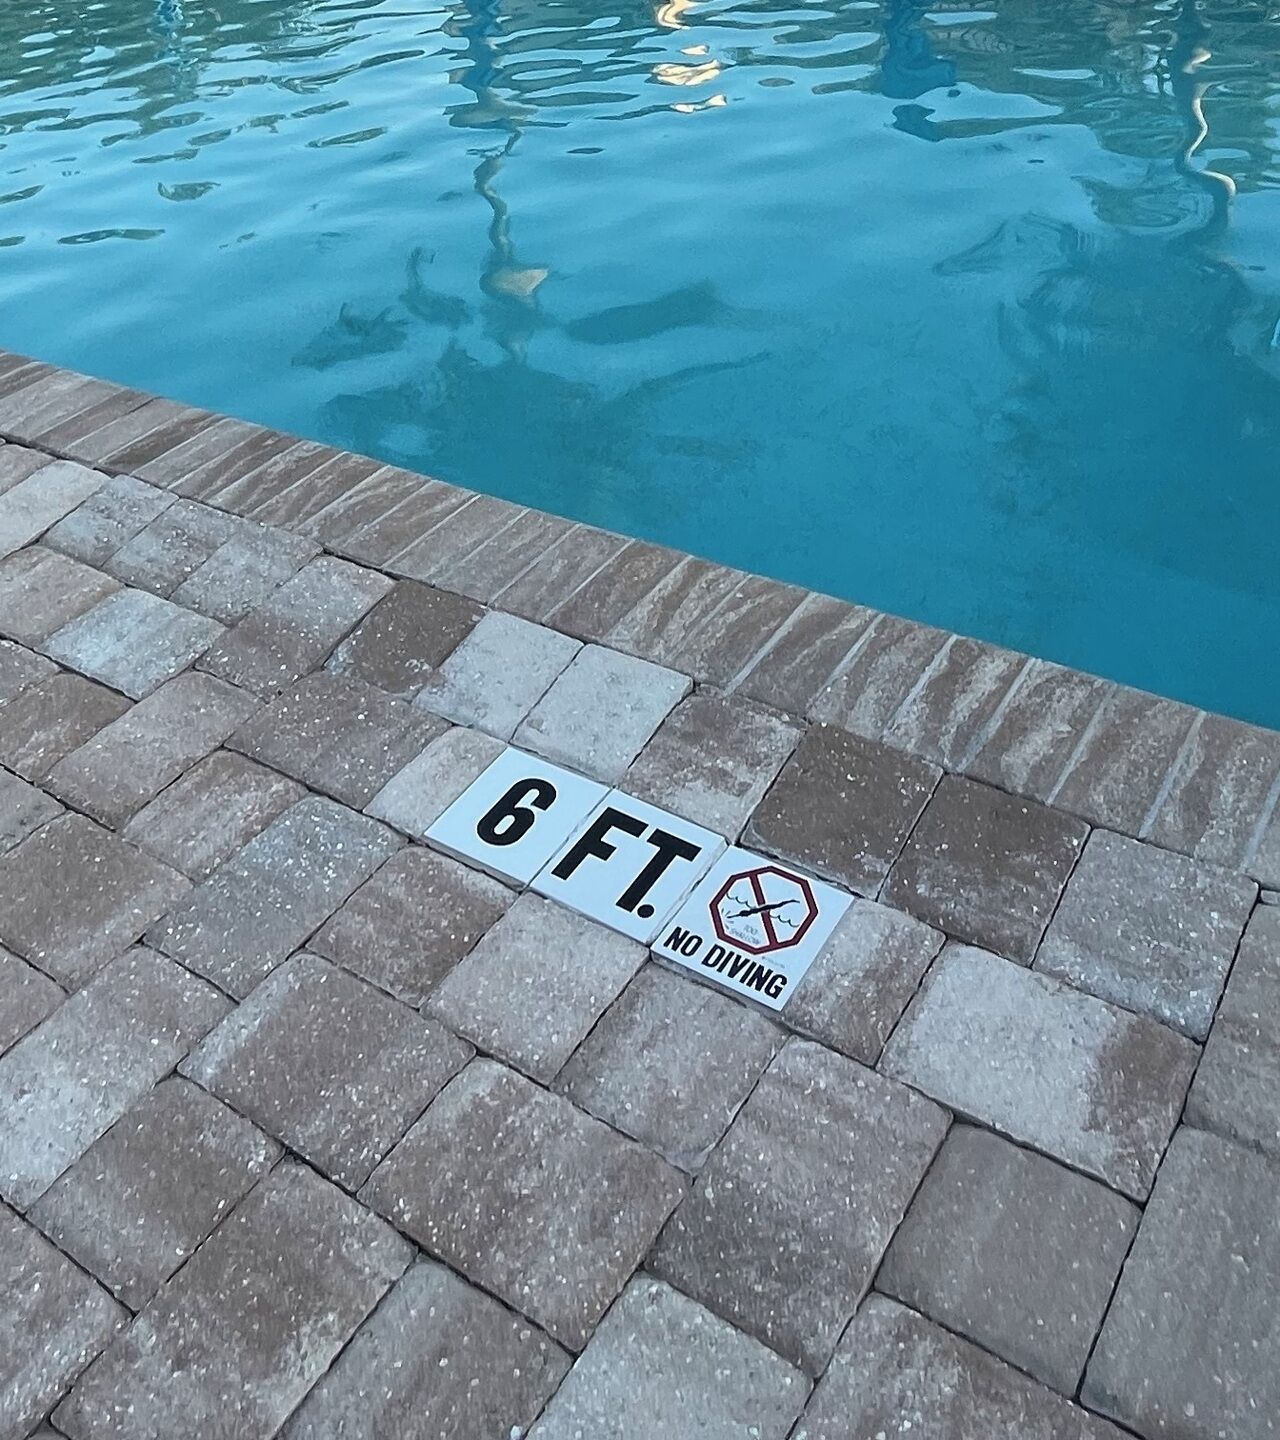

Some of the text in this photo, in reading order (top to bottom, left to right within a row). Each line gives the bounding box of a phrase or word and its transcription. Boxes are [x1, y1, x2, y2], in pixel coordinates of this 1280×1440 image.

[476, 778, 702, 918] 6 FT.
[663, 926, 788, 1000] NO DIVING
